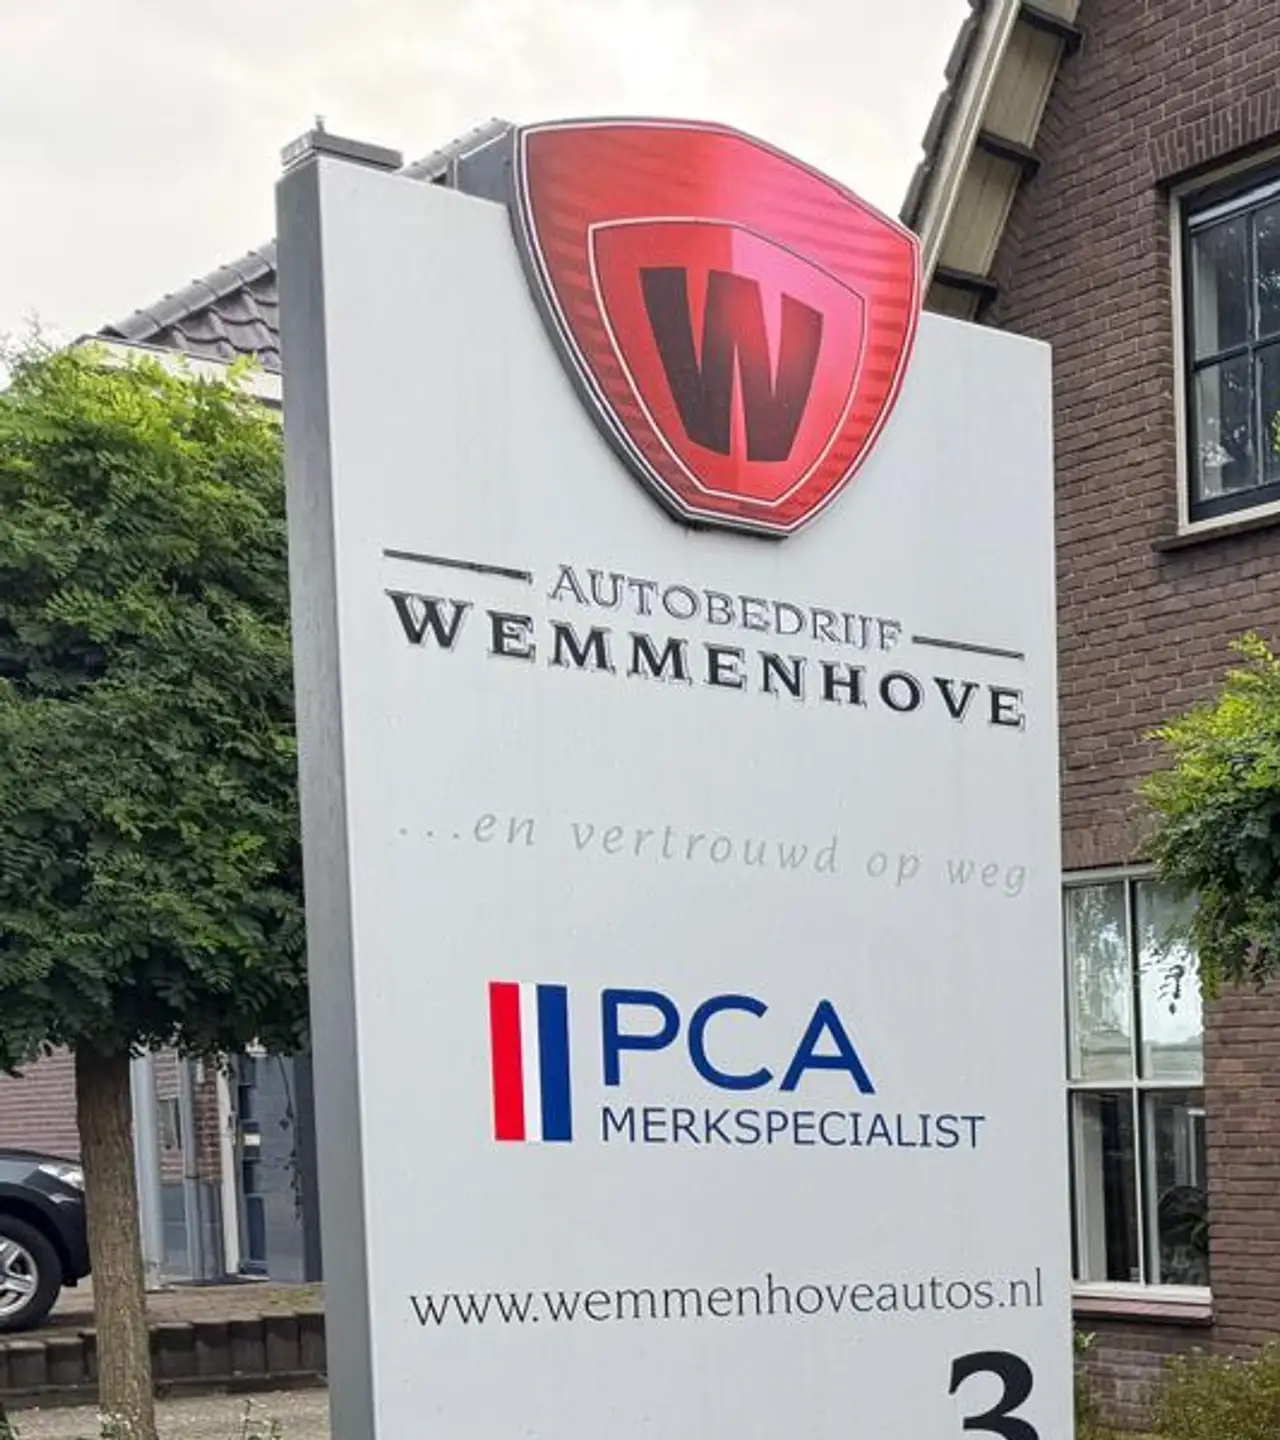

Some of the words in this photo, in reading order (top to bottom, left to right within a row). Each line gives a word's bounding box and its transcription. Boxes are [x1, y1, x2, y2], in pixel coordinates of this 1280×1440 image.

[639, 265, 824, 463] W
[548, 563, 903, 652] AUTOBEDRIJF
[384, 588, 1026, 730] WEMMENHOVE
[572, 817, 839, 874] vertrouwd
[867, 852, 923, 885] op
[947, 858, 1029, 899] weg
[601, 988, 876, 1094] PCA
[601, 1107, 986, 1149] MERKSPECIALIST
[409, 1268, 1044, 1327] www.wemmenhoveautos.nl
